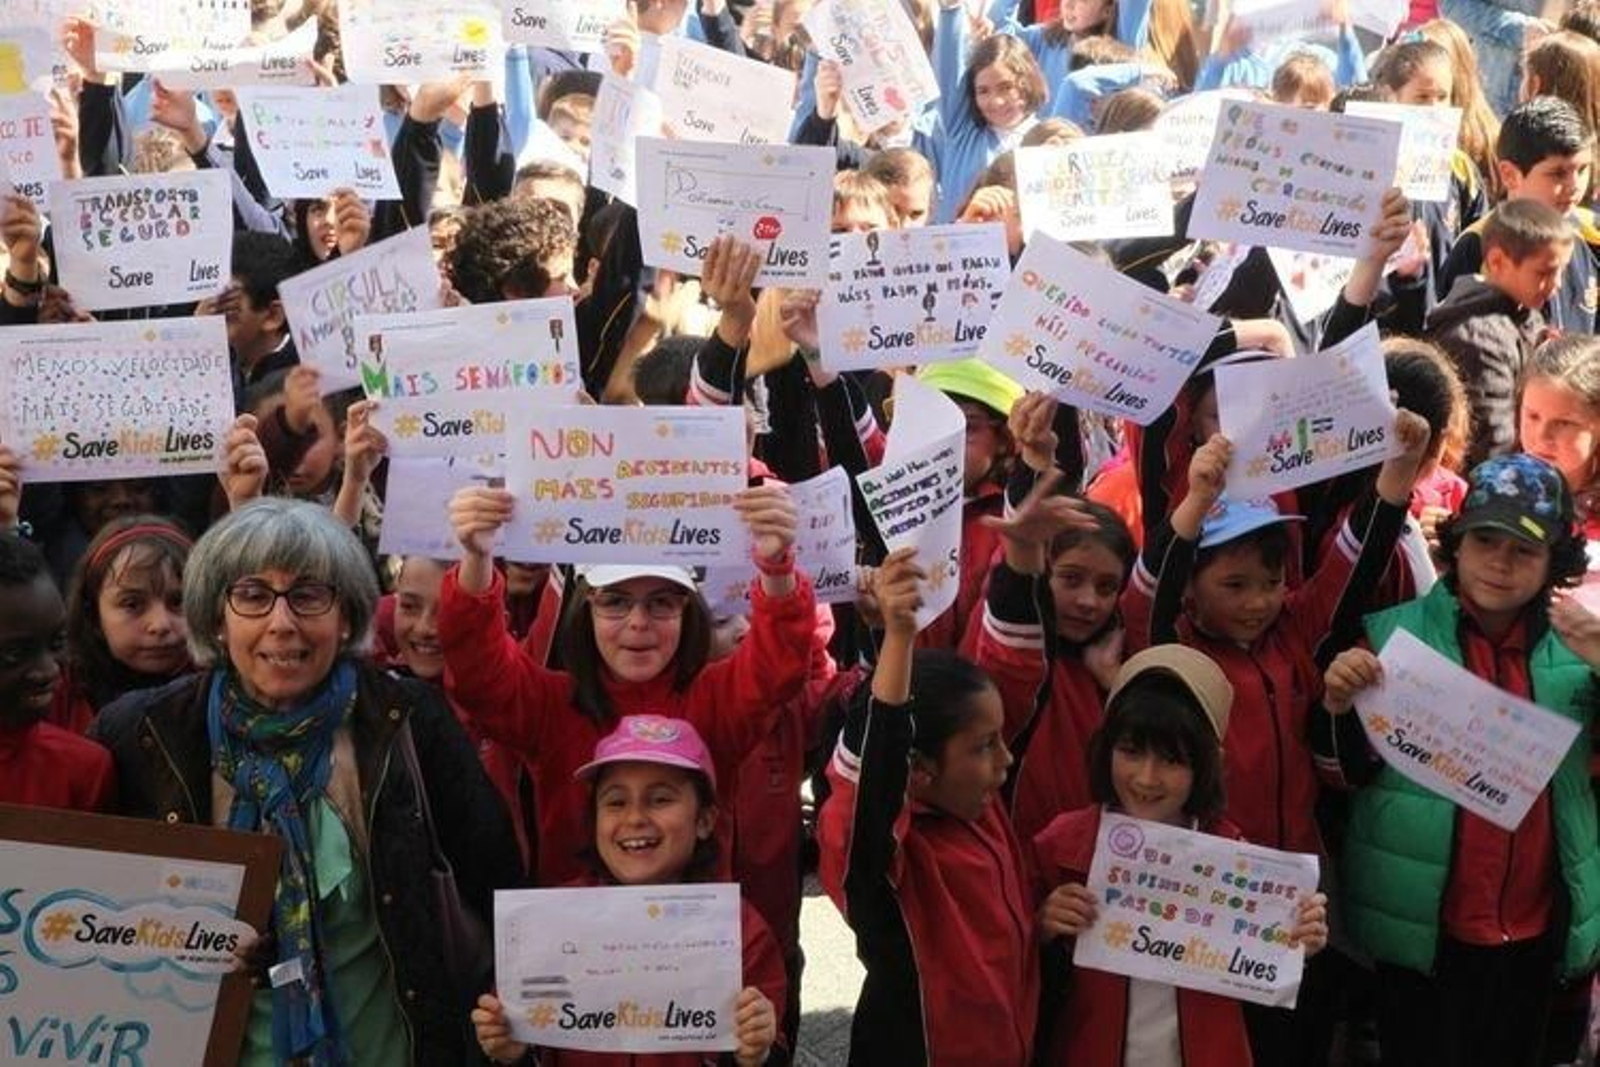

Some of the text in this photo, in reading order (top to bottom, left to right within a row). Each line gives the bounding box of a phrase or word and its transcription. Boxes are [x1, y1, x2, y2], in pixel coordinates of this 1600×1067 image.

[511, 7, 547, 29] Save
[108, 259, 220, 288] Save Lives
[33, 425, 214, 459] #SaveKidsLives
[534, 517, 721, 545] #SaveKidsLives
[41, 909, 239, 952] #SaveKidsLives
[1104, 922, 1278, 982] #SaveKidsLives
[527, 1000, 717, 1030] #SaveKidsLives
